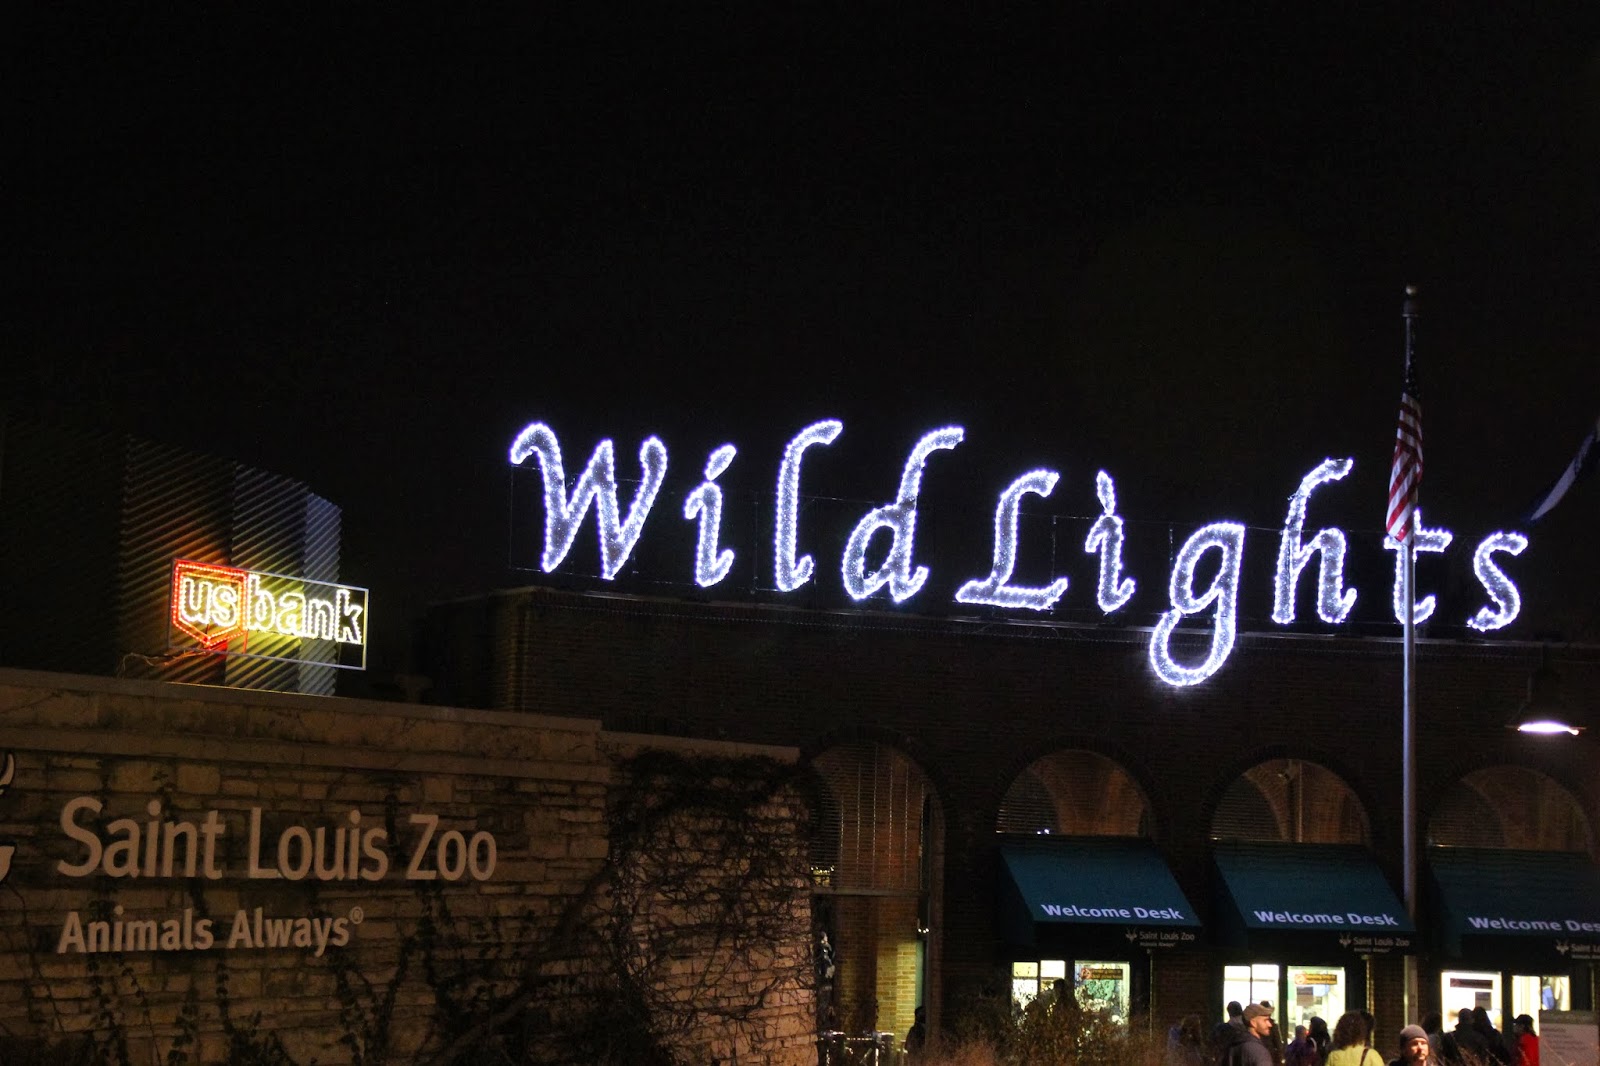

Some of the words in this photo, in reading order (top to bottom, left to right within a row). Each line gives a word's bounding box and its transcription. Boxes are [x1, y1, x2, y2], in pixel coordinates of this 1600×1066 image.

[57, 795, 227, 881] Saint
[248, 806, 390, 882] Louis
[406, 813, 499, 882] Zoo
[1041, 904, 1131, 919] Welcome
[1133, 907, 1185, 921] Desk
[1254, 910, 1344, 924] Welcome
[1347, 912, 1399, 926] Desk
[57, 905, 215, 954] Animals
[1468, 917, 1563, 931] Welcome
[1181, 932, 1195, 942] Zoo
